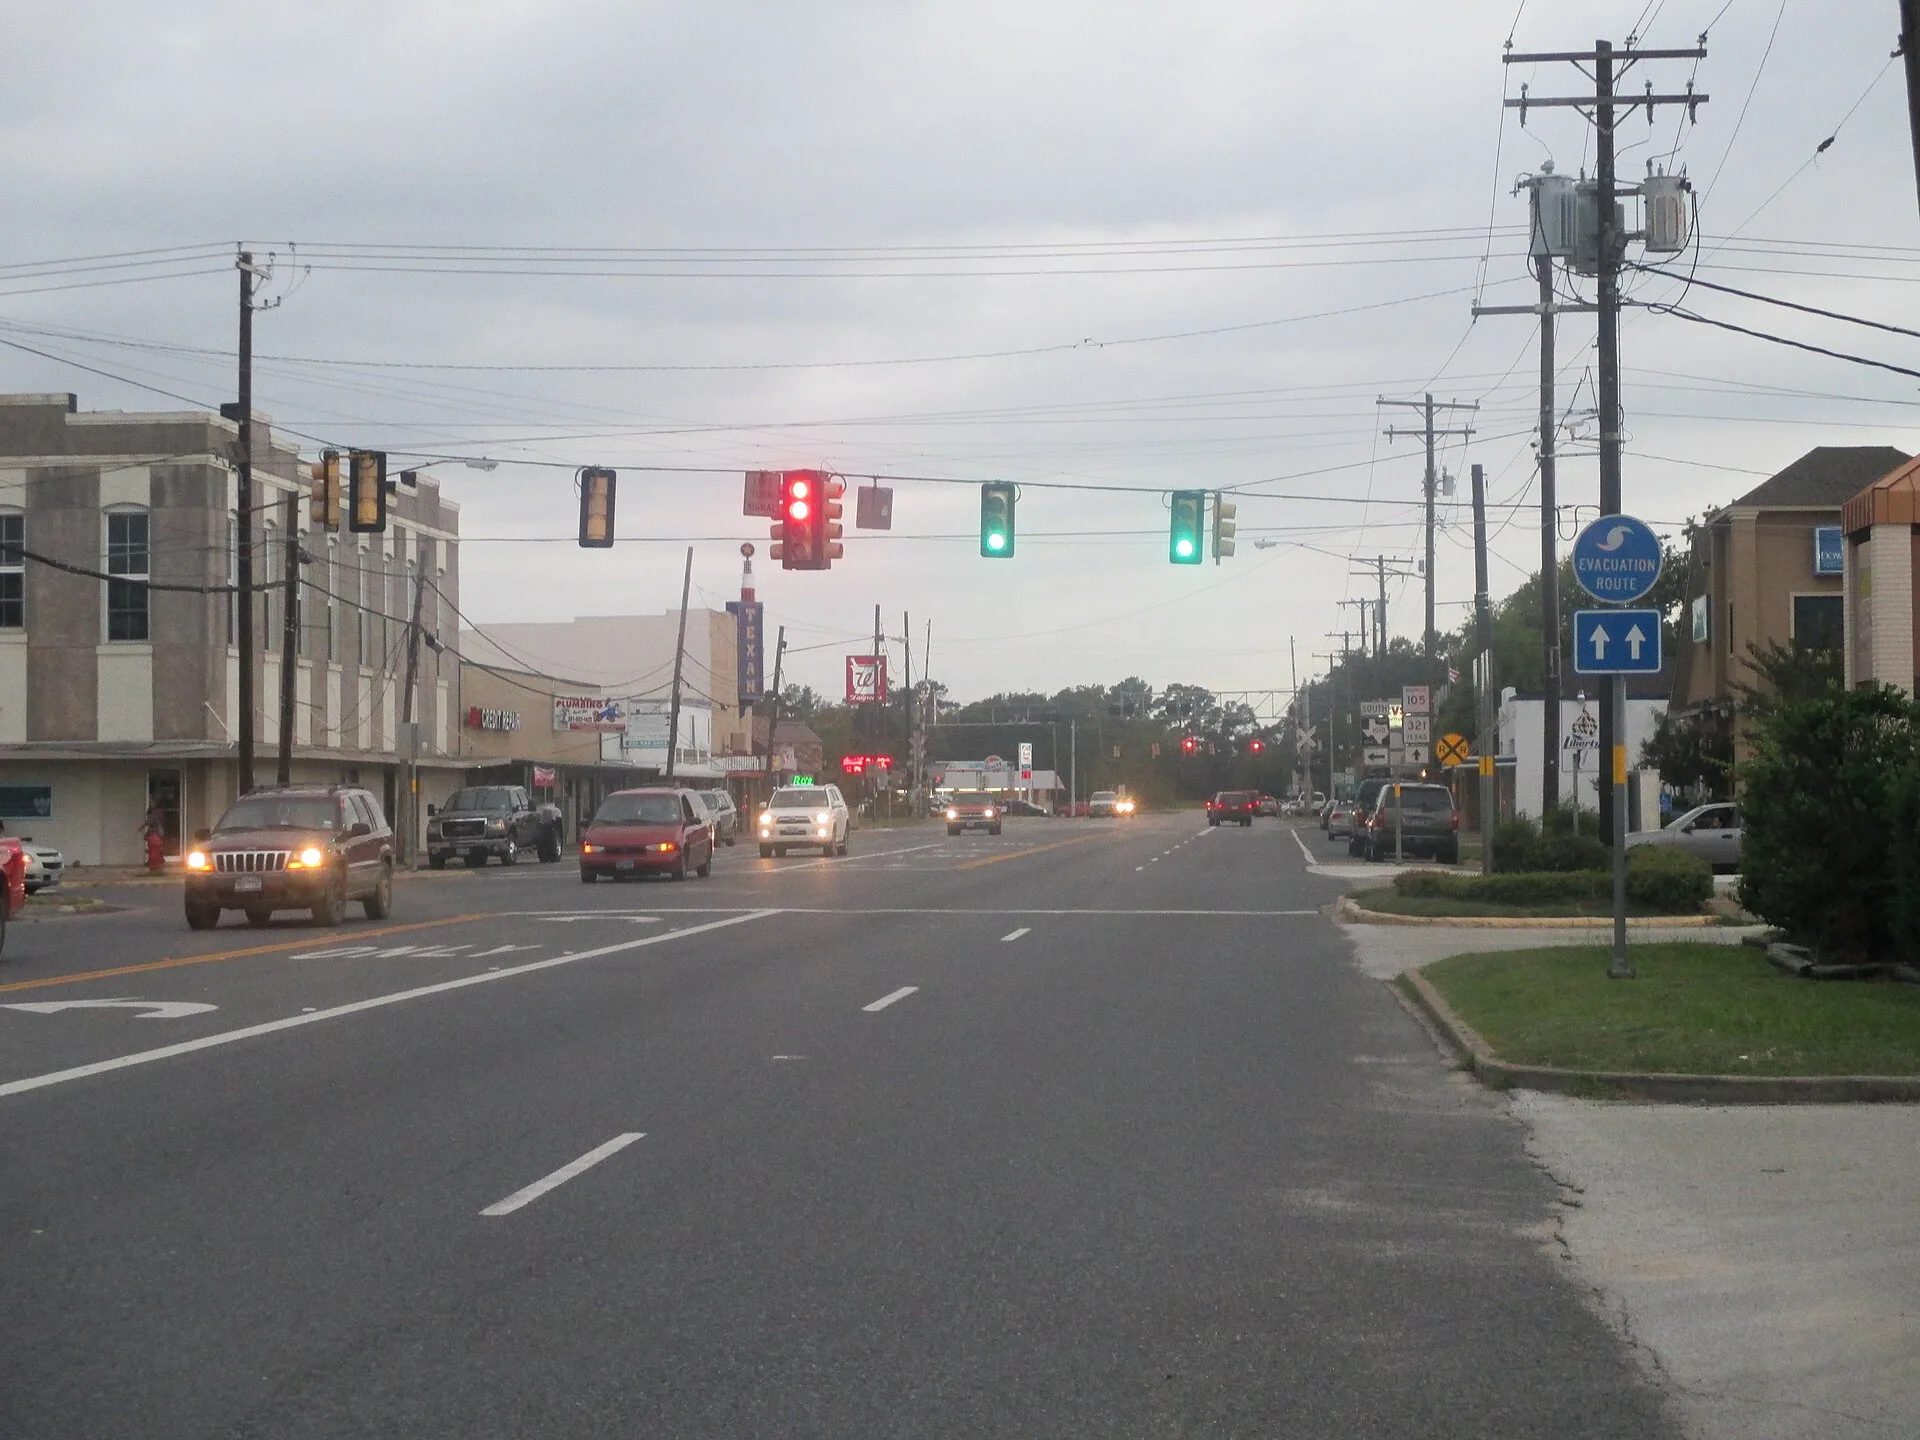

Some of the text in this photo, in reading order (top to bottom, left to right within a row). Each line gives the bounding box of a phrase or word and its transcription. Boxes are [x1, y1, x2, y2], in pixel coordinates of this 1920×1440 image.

[1579, 557, 1656, 572] EVACUATION
[1596, 576, 1637, 590] ROUTE
[745, 607, 755, 693] TEXAN
[556, 700, 604, 709] PLUMBING
[1407, 695, 1426, 705] 105
[1362, 704, 1388, 713] SOUTH
[1407, 720, 1426, 730] 321
[1439, 745, 1467, 753] R R
[1563, 736, 1600, 750] Liberty
[289, 944, 544, 960] ONLY
